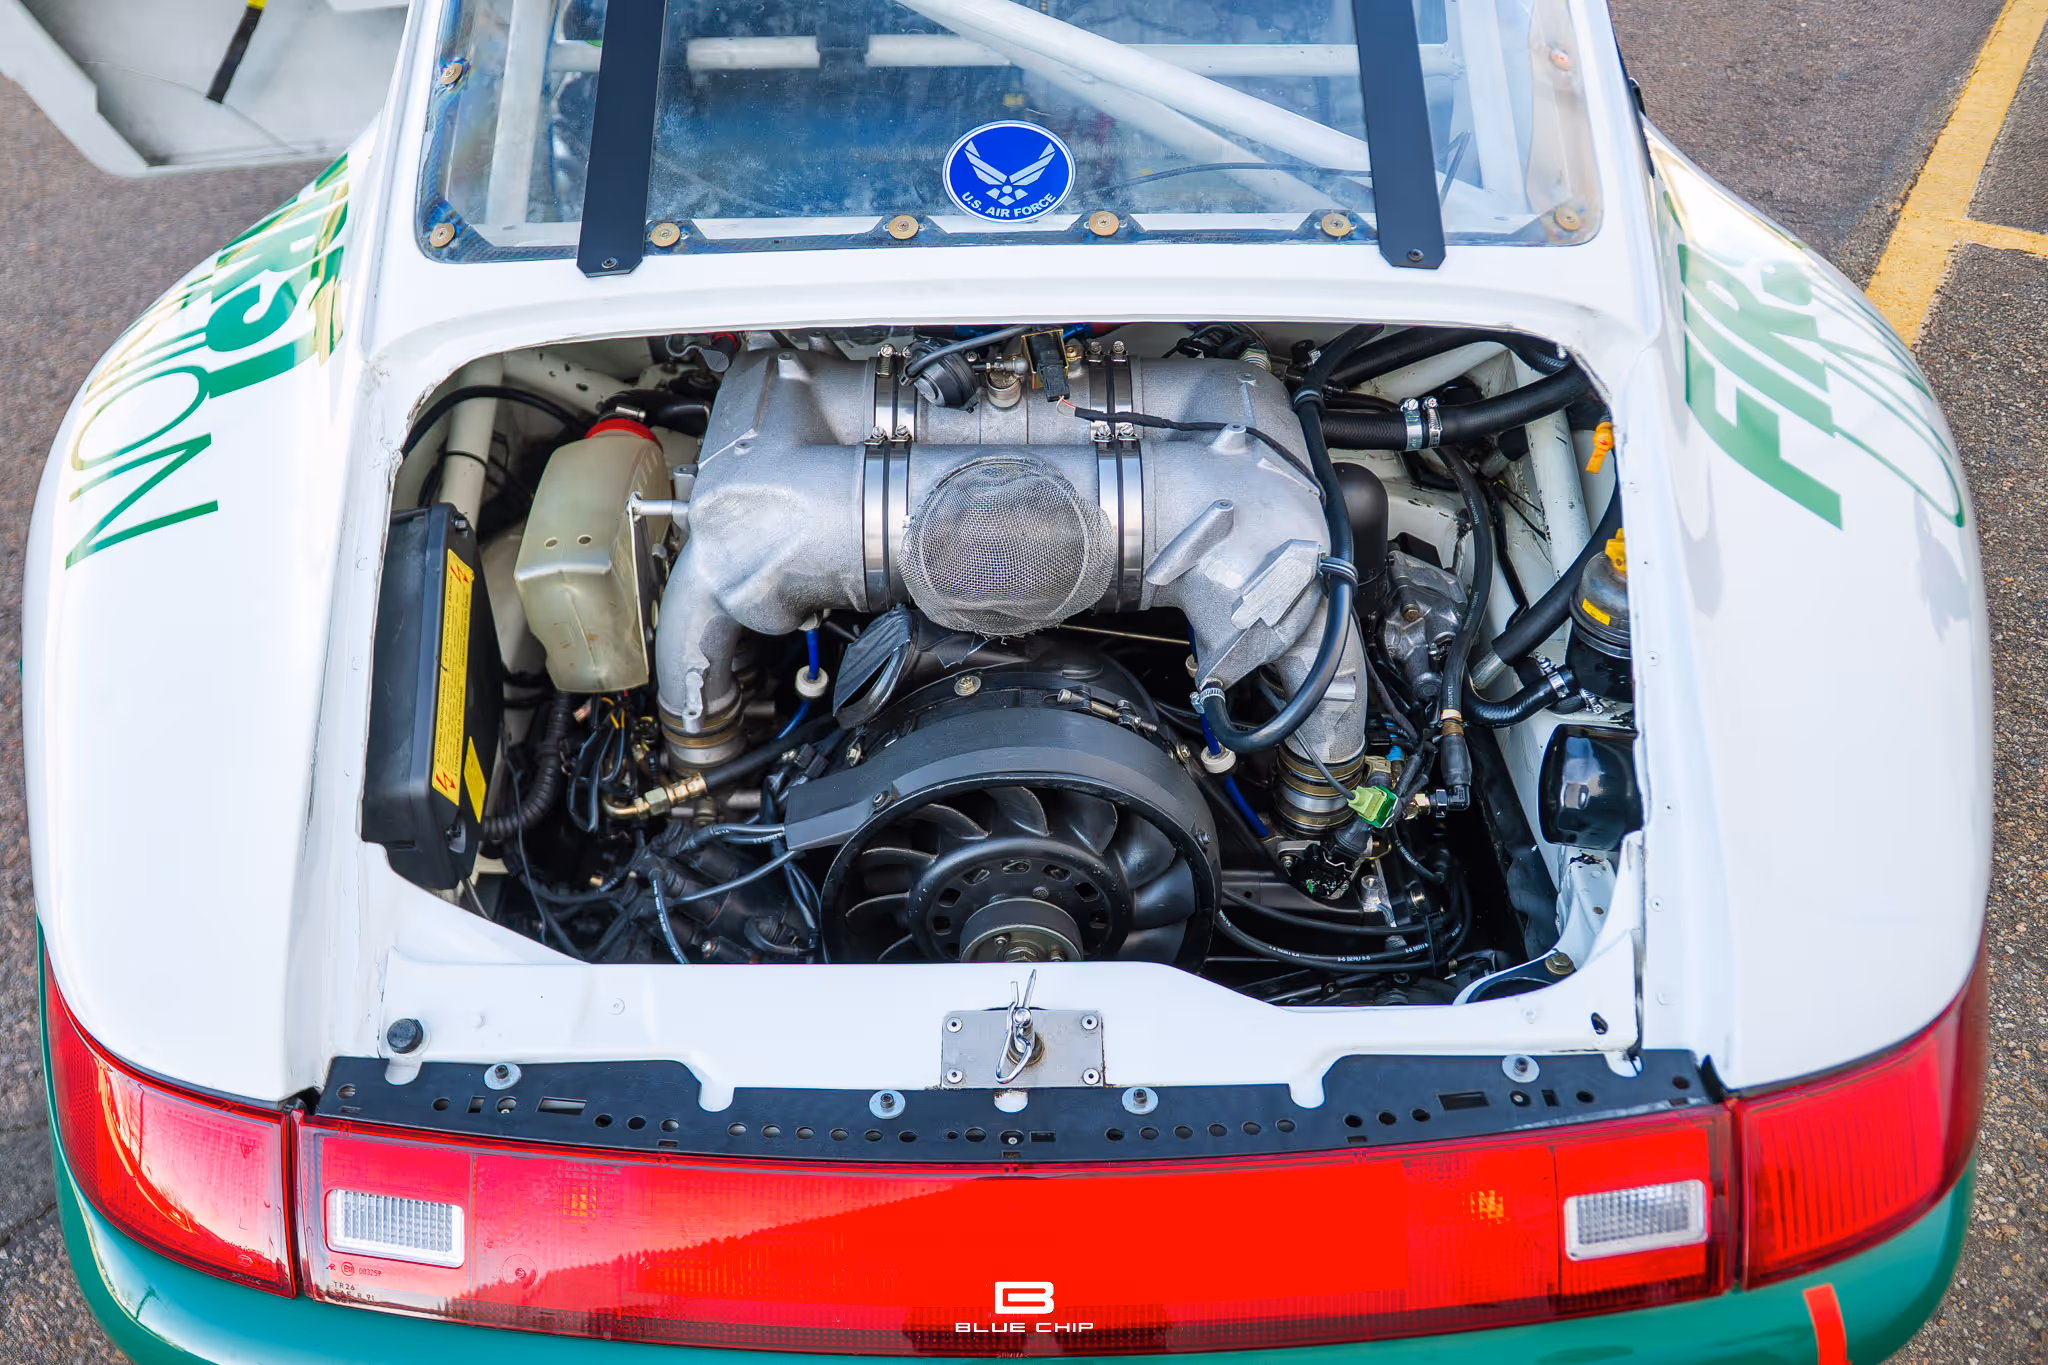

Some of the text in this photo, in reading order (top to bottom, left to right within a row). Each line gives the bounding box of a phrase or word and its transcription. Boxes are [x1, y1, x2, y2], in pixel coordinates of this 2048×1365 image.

[961, 191, 1057, 218] U.S. AIR FORCE
